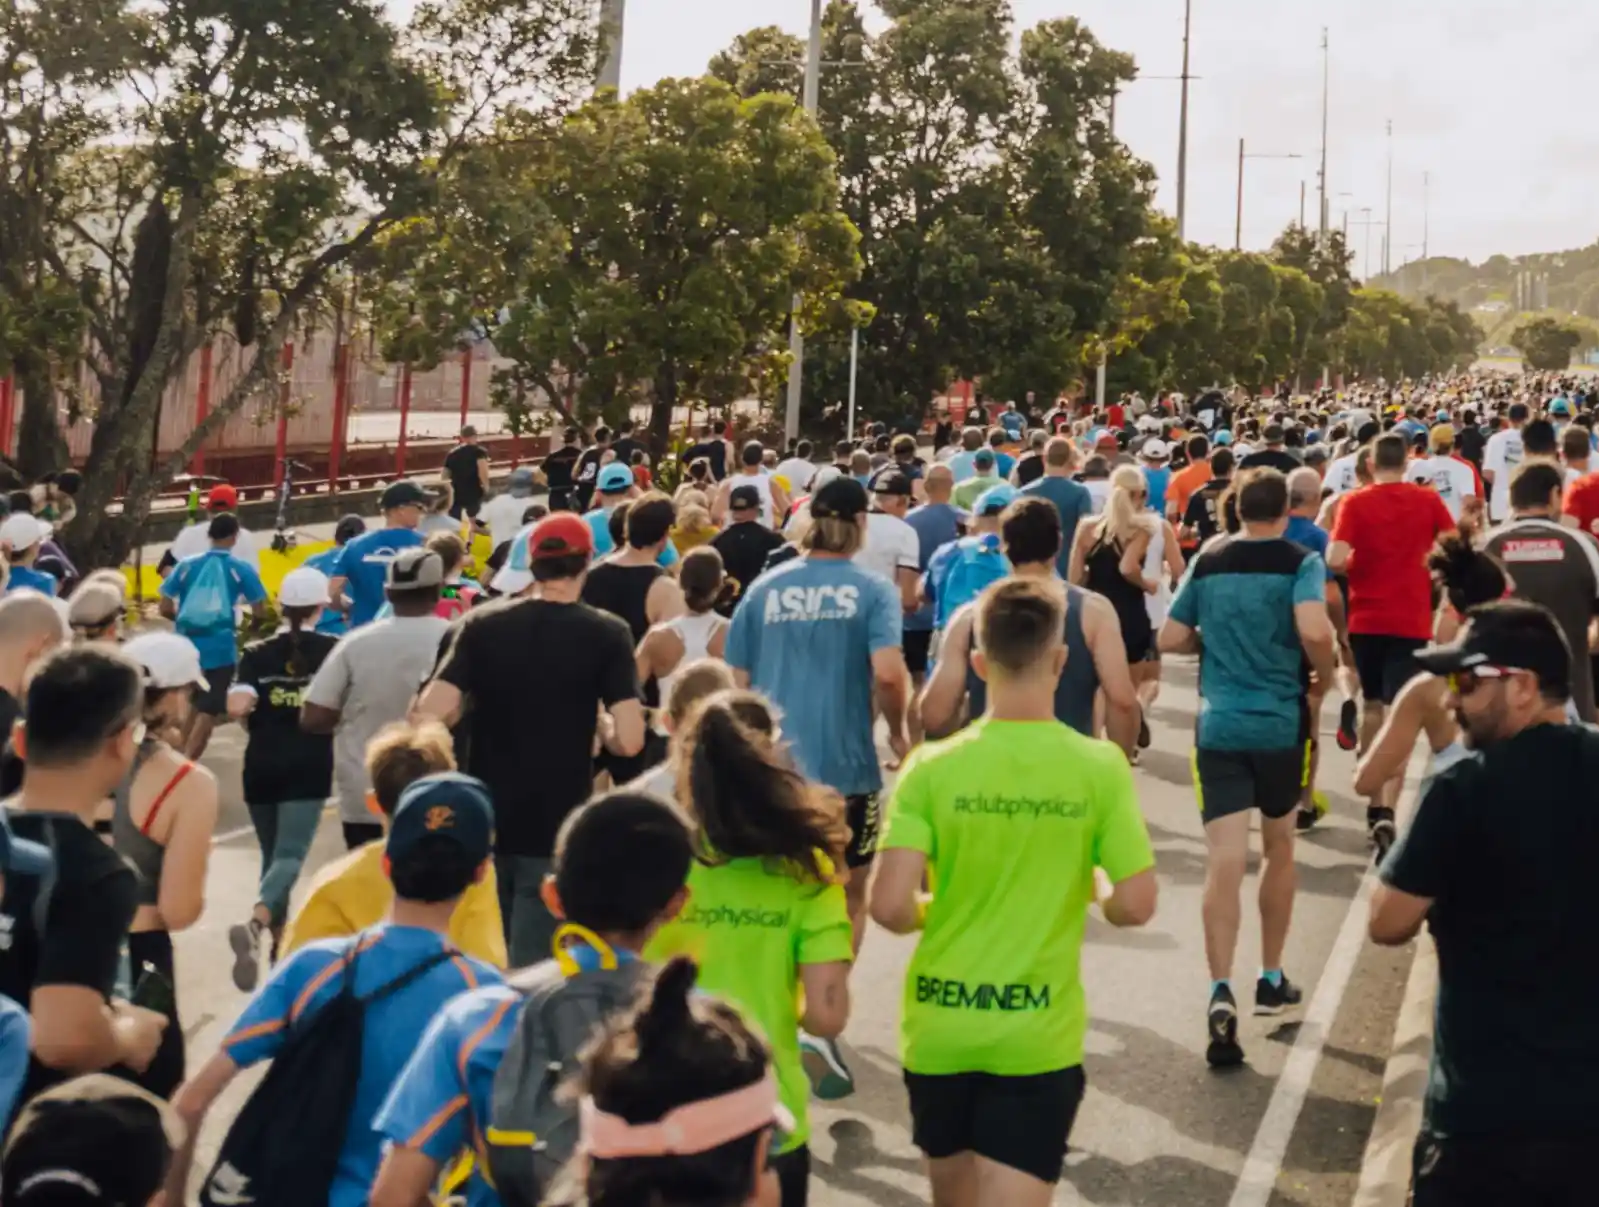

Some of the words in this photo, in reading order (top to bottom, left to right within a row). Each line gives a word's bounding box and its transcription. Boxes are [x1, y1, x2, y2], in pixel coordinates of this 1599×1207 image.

[764, 584, 860, 617] ASICS
[952, 792, 1088, 820] #clubphysical
[916, 975, 1050, 1011] BREMINEM
